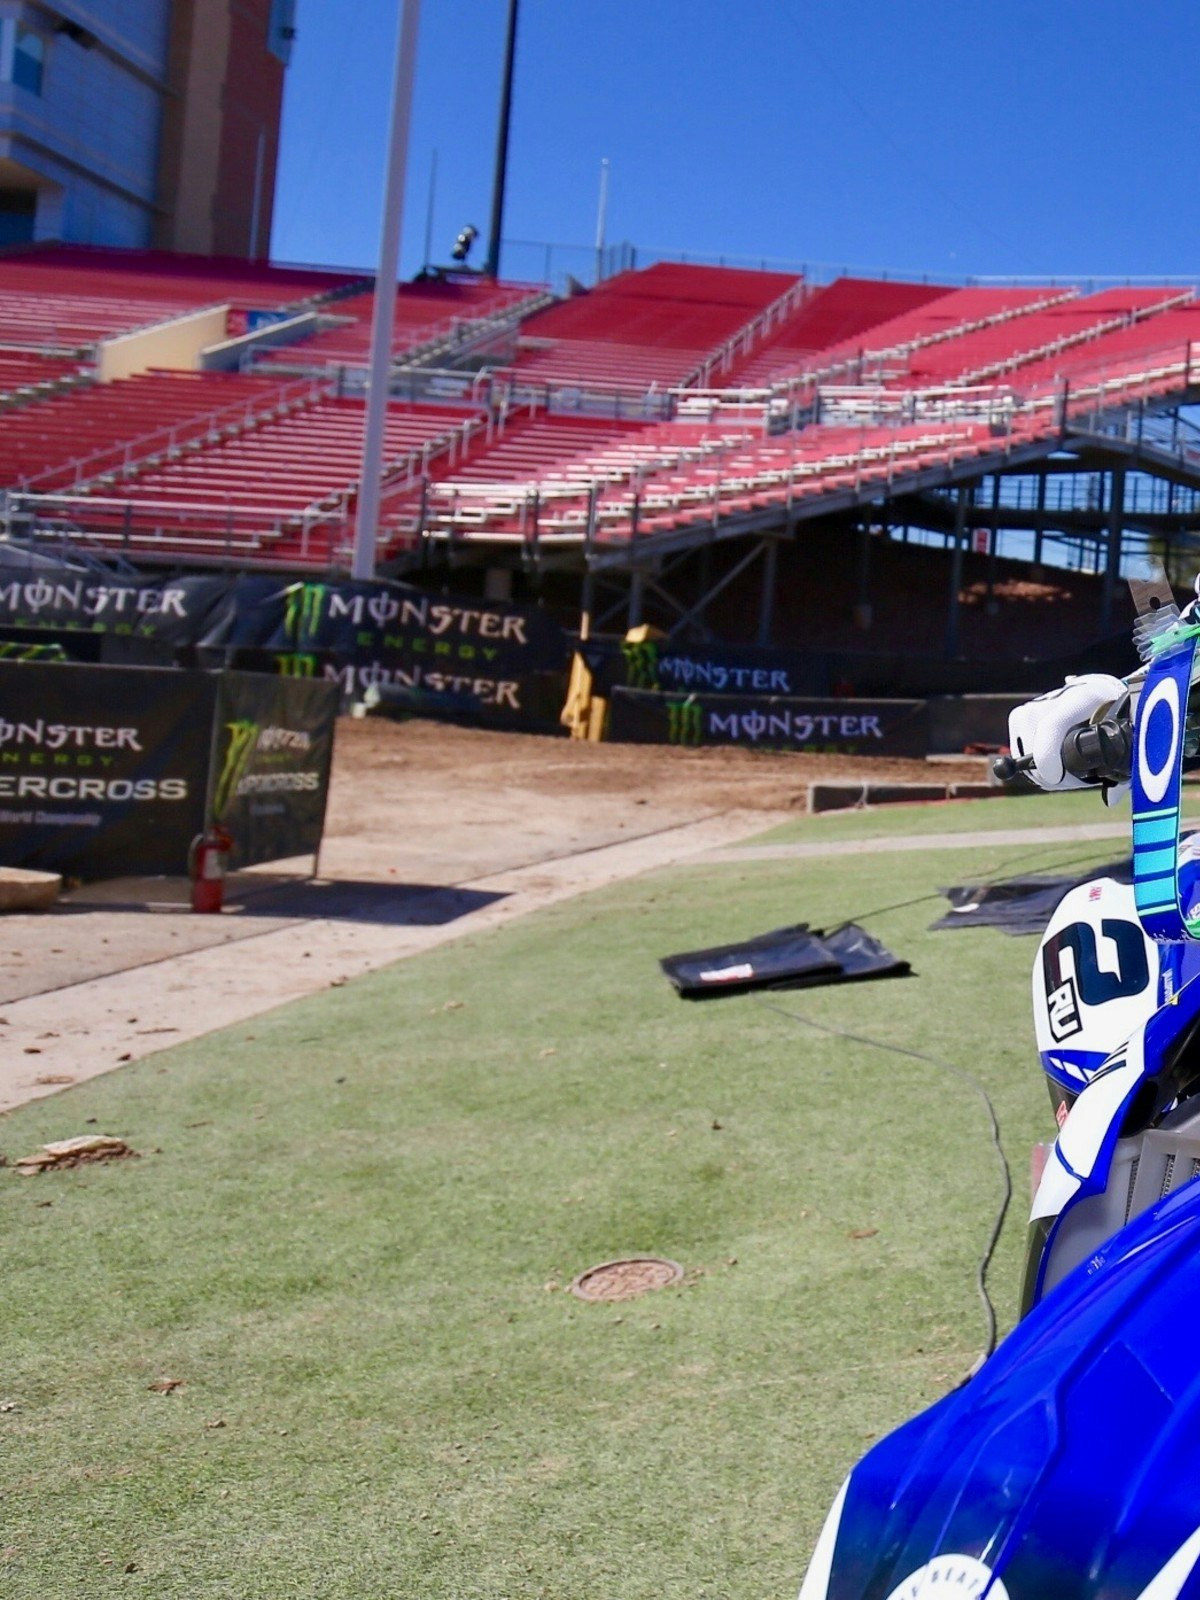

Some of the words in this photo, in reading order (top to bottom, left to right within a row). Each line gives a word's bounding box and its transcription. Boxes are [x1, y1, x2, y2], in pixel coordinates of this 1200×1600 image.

[328, 591, 528, 645] MONSTER
[324, 661, 521, 709] MONSTER
[659, 656, 791, 692] MONSTER
[710, 710, 883, 741] MONSTER
[1043, 918, 1150, 1006] 2
